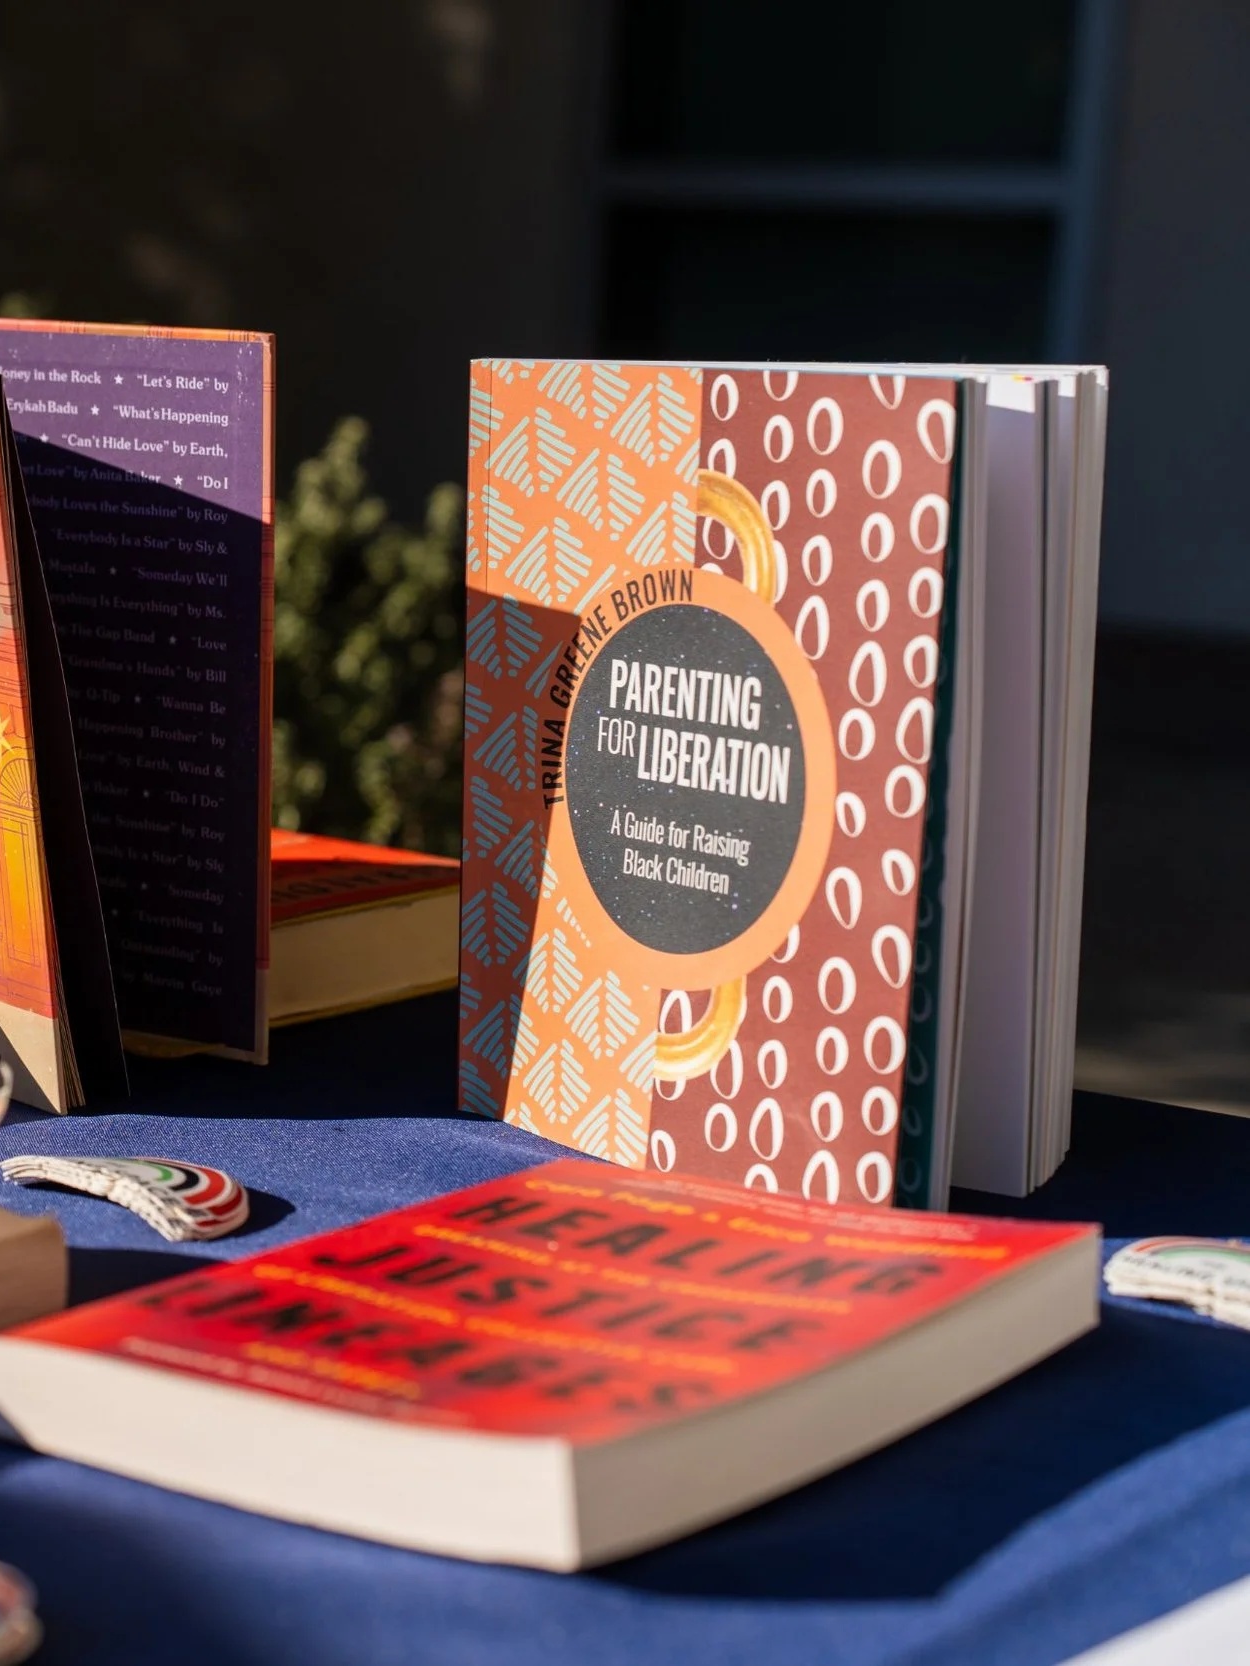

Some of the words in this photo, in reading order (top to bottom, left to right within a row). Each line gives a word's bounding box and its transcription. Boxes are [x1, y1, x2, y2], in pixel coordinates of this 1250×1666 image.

[34, 368, 45, 381] in
[49, 369, 68, 382] the
[70, 370, 102, 384] Rock
[137, 374, 172, 389] "Let's
[176, 376, 210, 390] Ride"
[214, 378, 229, 393] by
[6, 398, 46, 414] Erykah
[48, 401, 79, 415] Badu
[113, 404, 160, 420] "What's
[161, 407, 229, 427] Happening
[61, 433, 100, 448] "Can't
[103, 435, 132, 450] Hide
[134, 437, 169, 453] Love"
[172, 441, 187, 457] by
[73, 465, 88, 482] by
[90, 467, 123, 482] Anita
[124, 470, 161, 486] Baker
[197, 475, 222, 490] "Do
[224, 477, 229, 490] I
[62, 496, 97, 511] Loves
[100, 499, 119, 514] the
[121, 500, 183, 519] Sunshine"
[186, 507, 201, 523] by
[204, 508, 229, 525] Roy
[121, 532, 132, 546] Is
[134, 536, 141, 547] a
[178, 539, 193, 555] by
[195, 540, 214, 556] Sly
[216, 542, 229, 556] &
[195, 571, 228, 588] We'll
[610, 569, 694, 623] BROWN
[187, 602, 202, 618] by
[205, 604, 227, 620] Ms.
[550, 604, 613, 709] GREENE
[186, 667, 202, 682] by
[205, 669, 227, 683] Bill
[209, 701, 227, 715] Be
[608, 658, 763, 732] PARENTING
[210, 732, 226, 749] by
[178, 760, 210, 777] Wind
[214, 765, 226, 779] &
[541, 717, 566, 810] TRINA
[597, 715, 636, 758] FOR
[637, 725, 792, 805] LIBERATION
[200, 827, 226, 844] Roy
[610, 809, 622, 837] A
[624, 811, 664, 846] Guide
[668, 821, 691, 851] for
[693, 824, 751, 867] Raising
[623, 848, 662, 883] Black
[666, 856, 730, 896] Children
[454, 1196, 942, 1295] HEALING
[313, 1246, 830, 1351] JUSTICE
